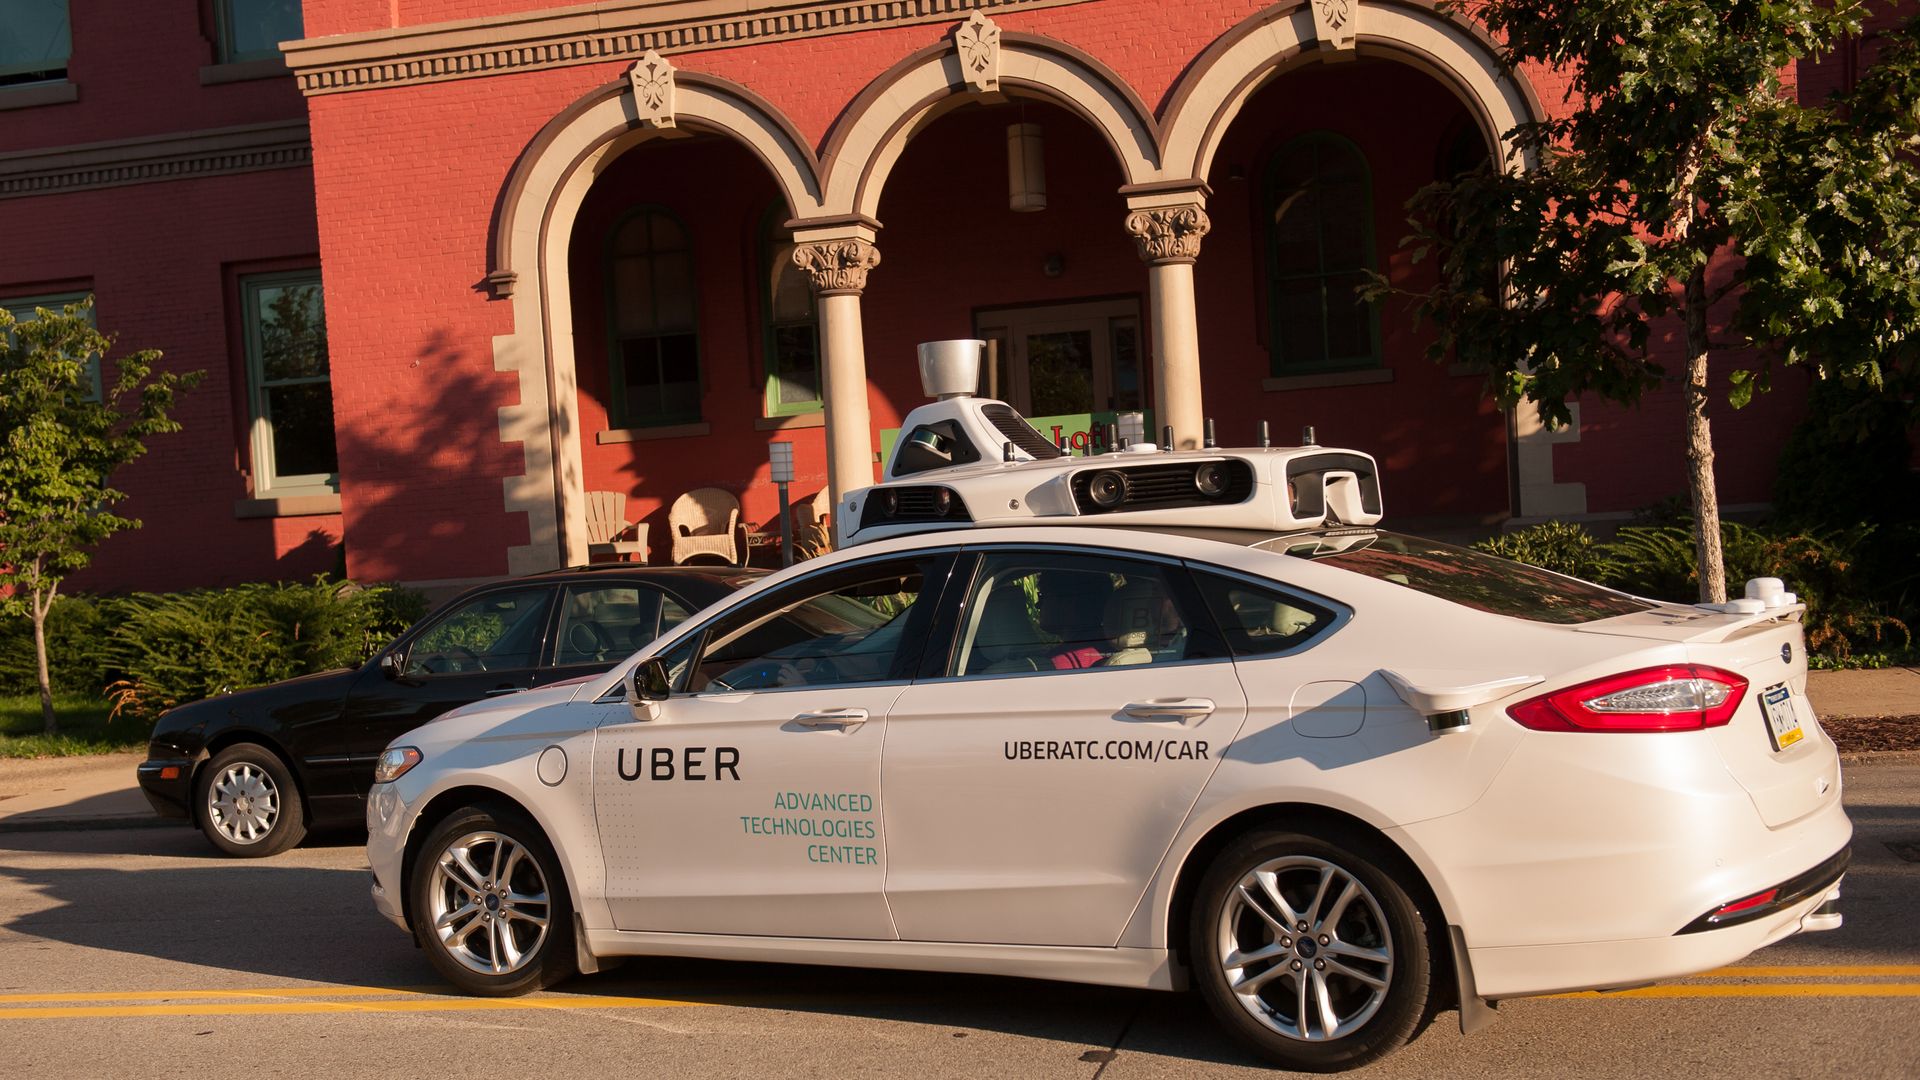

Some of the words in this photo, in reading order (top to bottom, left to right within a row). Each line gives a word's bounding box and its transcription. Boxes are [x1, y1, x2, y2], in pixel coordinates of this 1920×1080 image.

[1004, 740, 1209, 762] UBERATC.COM/CAR
[617, 747, 741, 781] UBER
[774, 792, 873, 812] ADVANCED
[740, 816, 876, 839] TECHNOLOGIES
[808, 845, 878, 865] CENTER
